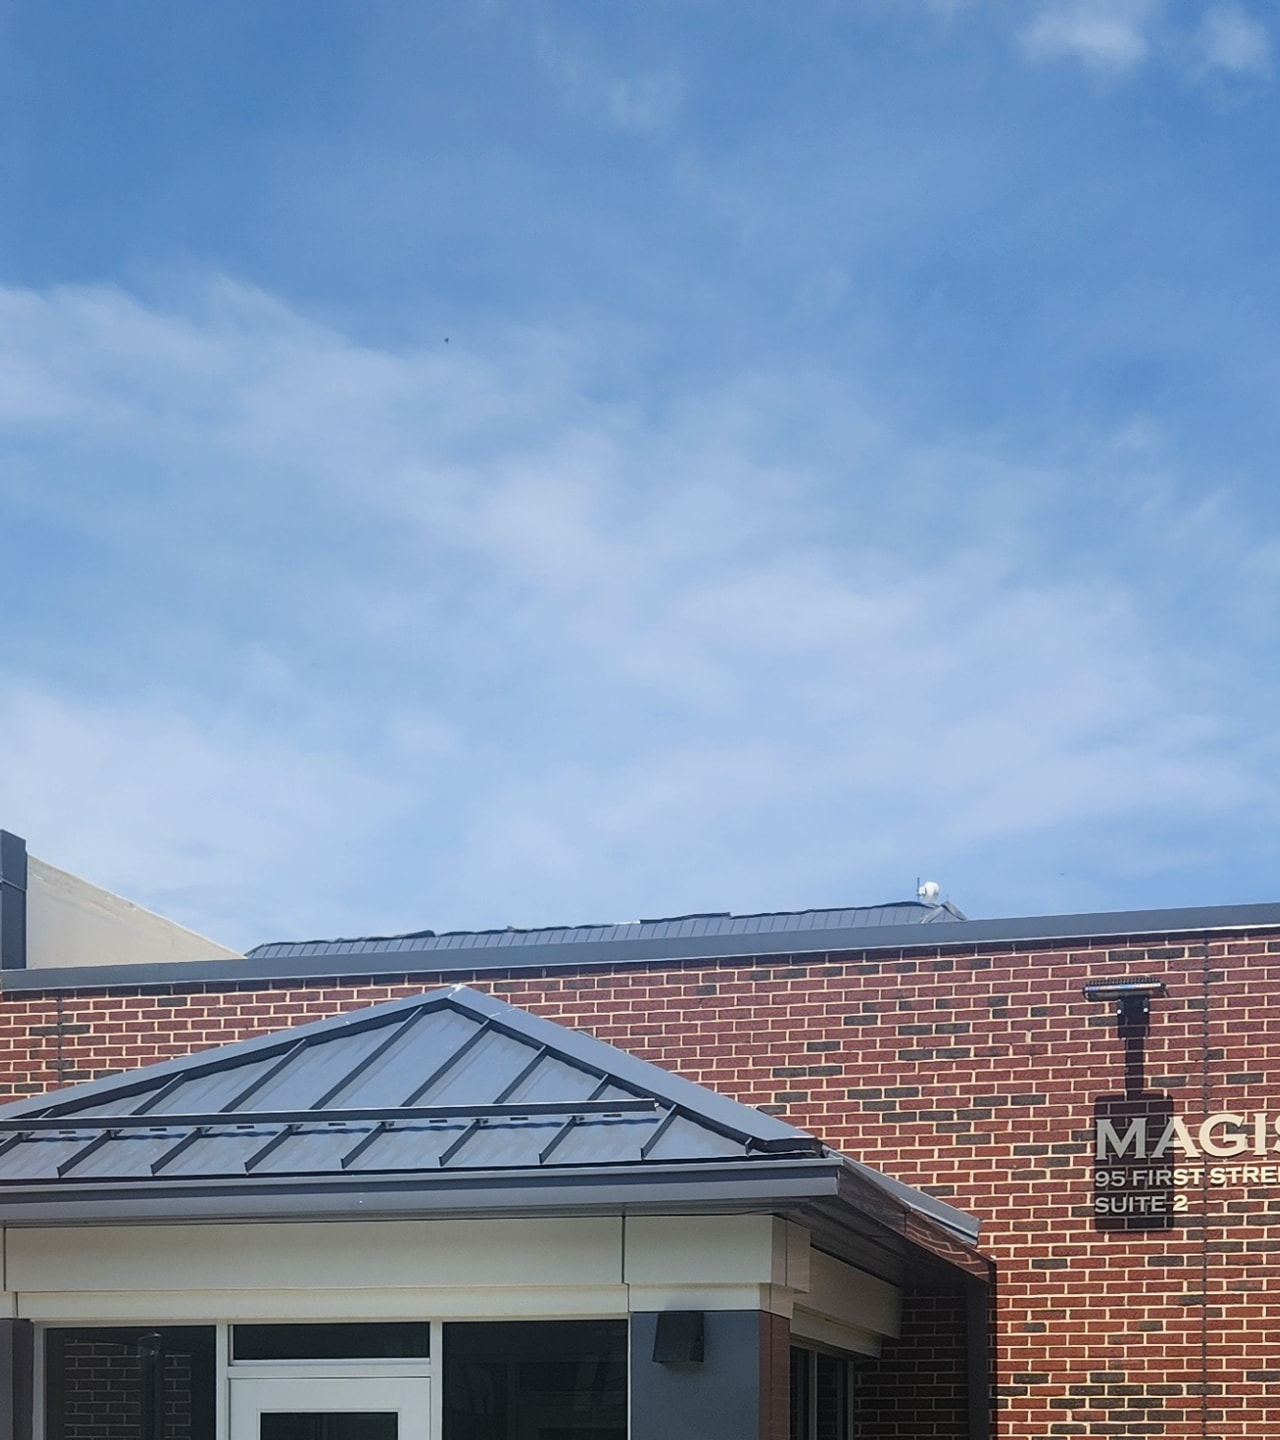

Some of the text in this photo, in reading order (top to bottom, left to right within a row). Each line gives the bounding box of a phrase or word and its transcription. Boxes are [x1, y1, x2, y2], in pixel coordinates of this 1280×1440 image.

[1095, 1170, 1126, 1187] 95
[1132, 1168, 1205, 1186] FIRST
[1094, 1194, 1188, 1214] SUITE 2
